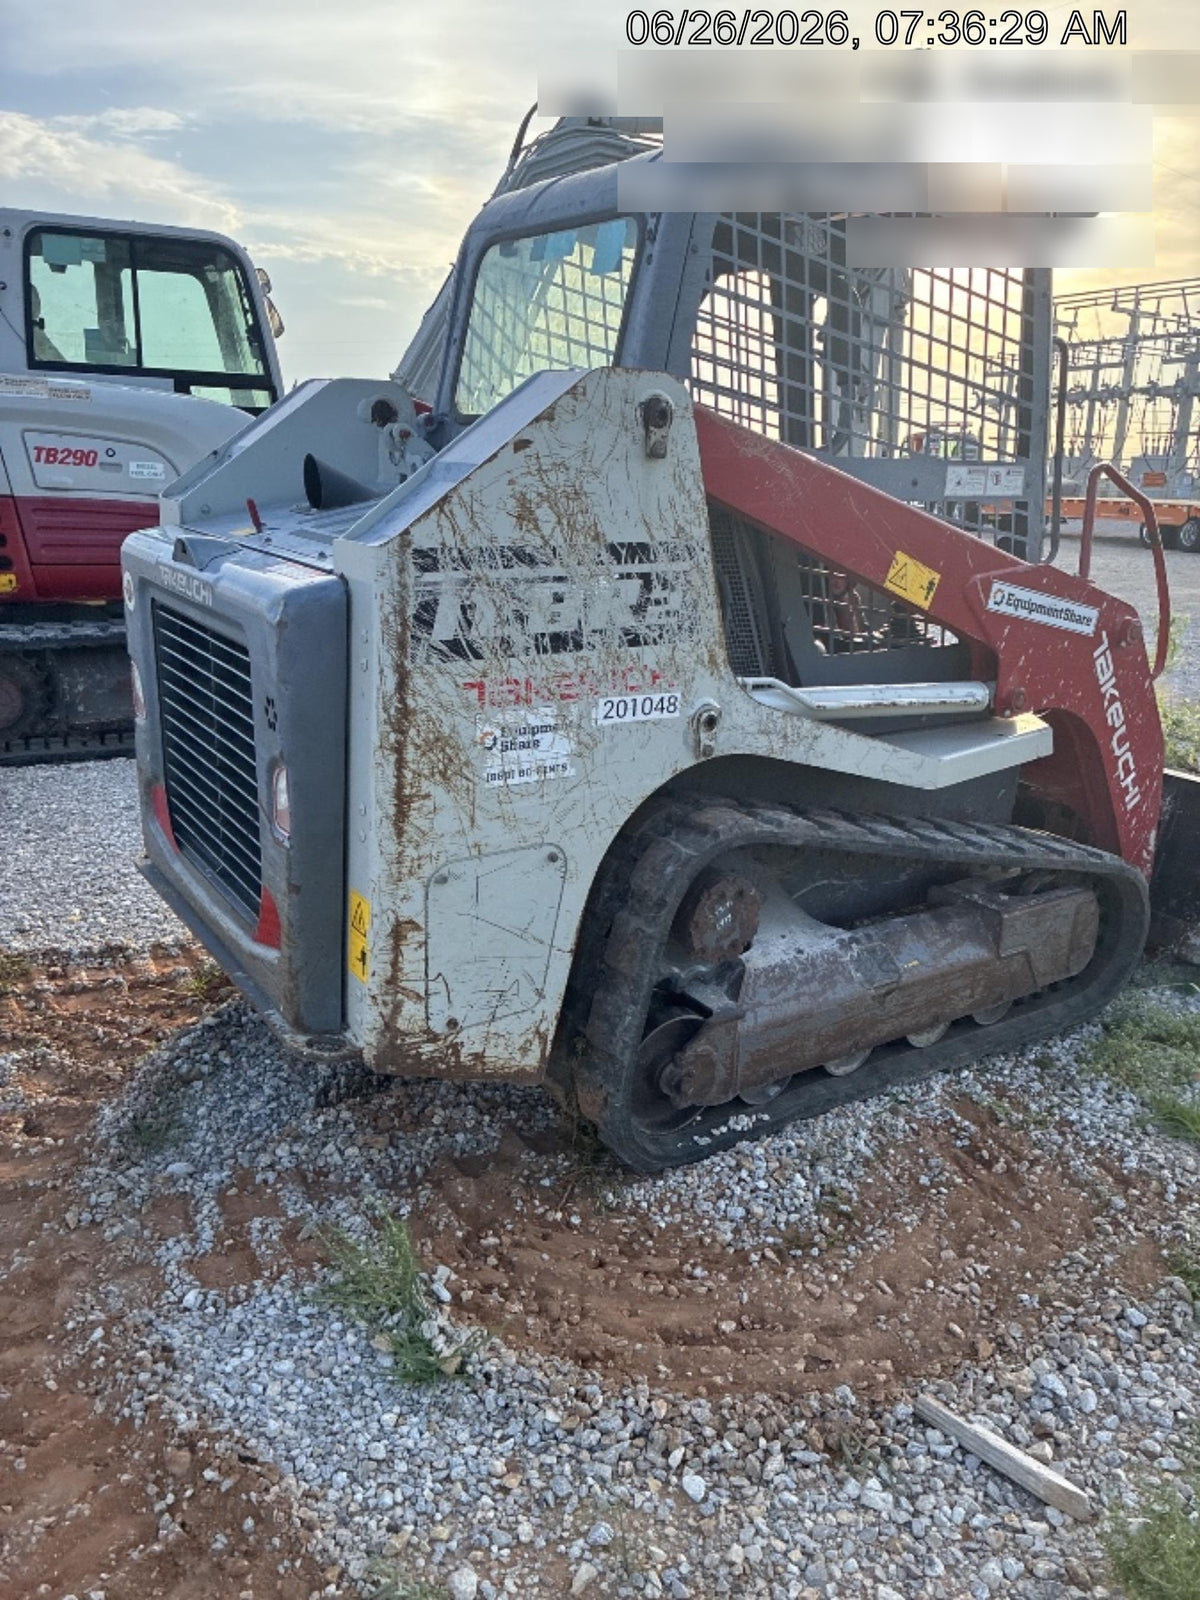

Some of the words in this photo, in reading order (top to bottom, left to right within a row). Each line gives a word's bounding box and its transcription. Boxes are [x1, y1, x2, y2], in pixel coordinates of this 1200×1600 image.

[33, 446, 98, 467] TB290
[1004, 592, 1093, 627] EquipmentShare
[602, 694, 679, 720] 201048
